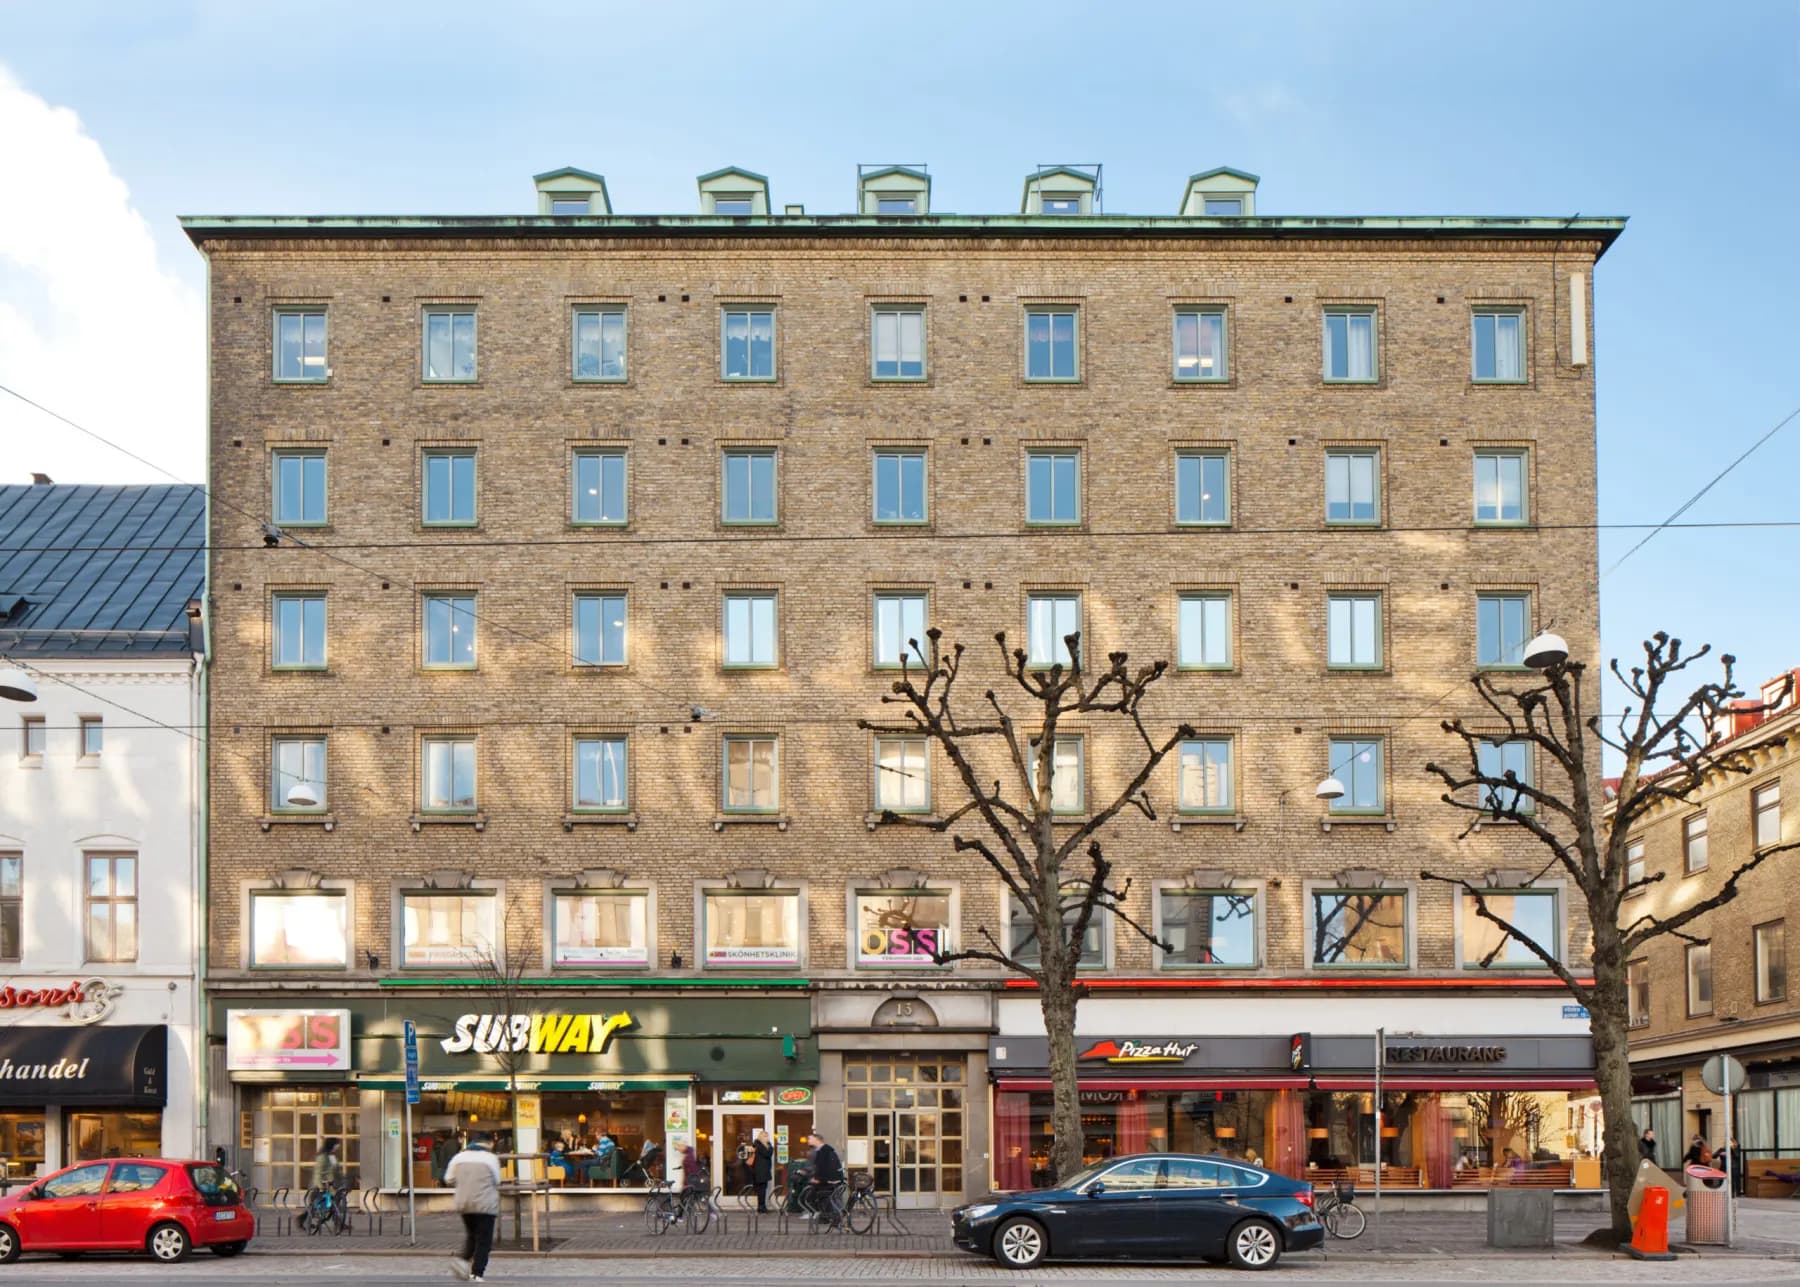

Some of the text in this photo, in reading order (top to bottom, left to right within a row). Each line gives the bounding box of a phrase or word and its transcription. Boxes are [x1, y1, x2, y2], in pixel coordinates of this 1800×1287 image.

[862, 929, 936, 955] OSS
[728, 950, 797, 958] SKÖNHETSKLINIK
[407, 1022, 415, 1045] P
[440, 1011, 633, 1055] SUBWAY
[1118, 1041, 1198, 1057] Pizza Hut
[1386, 1047, 1507, 1063] RESTAURANG
[722, 1090, 766, 1102] SUBWAY
[781, 1090, 807, 1101] OPEN
